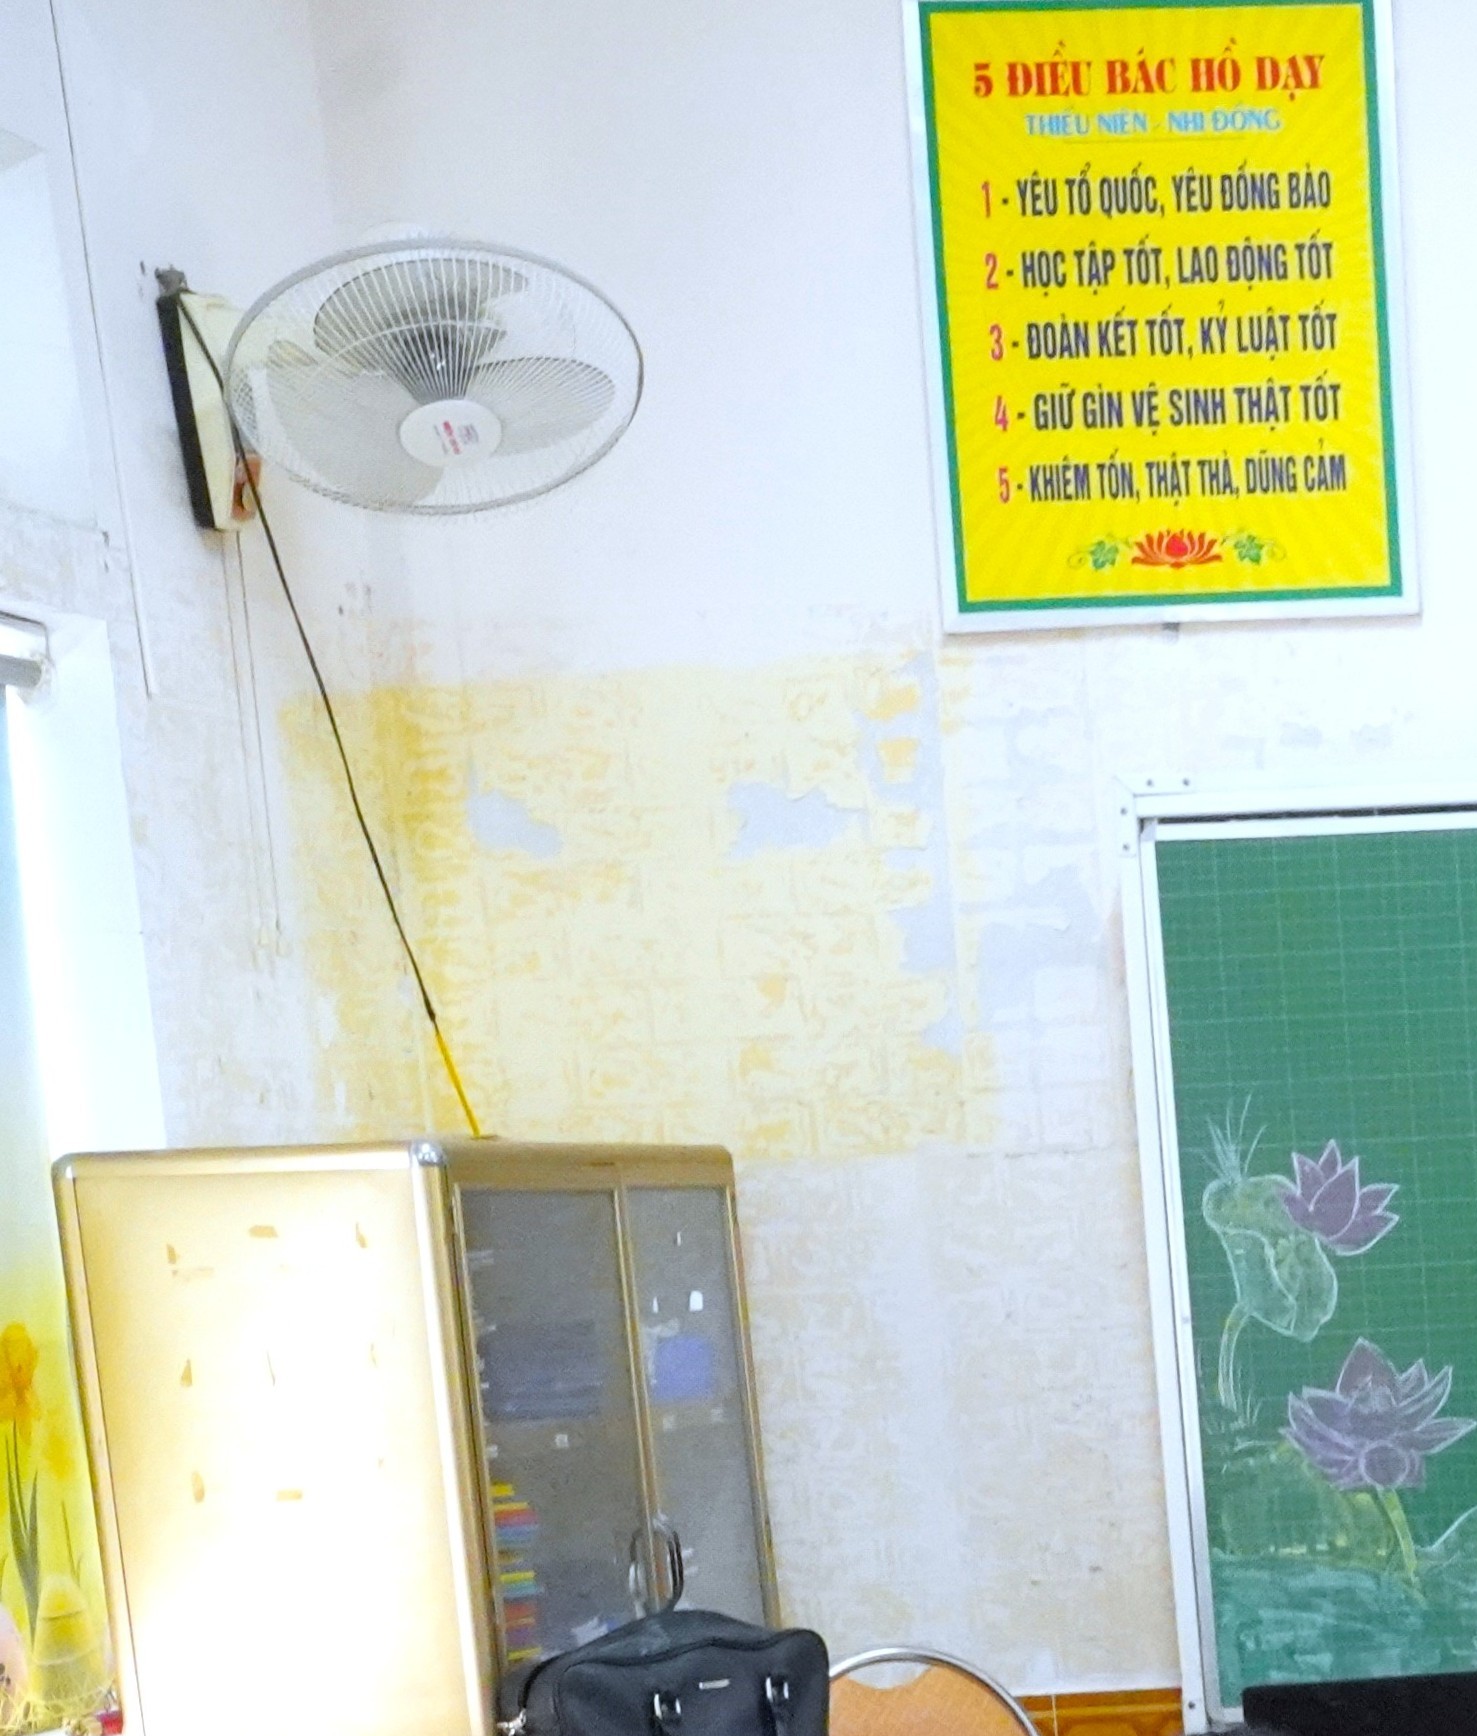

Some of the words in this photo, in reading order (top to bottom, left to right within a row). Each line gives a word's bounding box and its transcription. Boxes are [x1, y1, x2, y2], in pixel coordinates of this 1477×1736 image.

[974, 62, 993, 98] 5
[1006, 40, 1092, 97] ĐIỀU
[1105, 47, 1176, 94] BÁC
[1191, 37, 1241, 93] HỒ
[1256, 54, 1325, 101] DẠY
[1168, 109, 1204, 132] NHI
[982, 181, 992, 218] 1
[1017, 170, 1057, 217] YÊU
[1065, 162, 1091, 215] TỔ
[1100, 162, 1165, 219] QUỐC,
[1172, 167, 1212, 213] YÊU
[985, 252, 999, 290] 2
[1022, 250, 1067, 297] HỌC
[1074, 241, 1115, 296] TẬP
[1177, 246, 1218, 284] LAO
[1226, 236, 1288, 291] ĐỘNG
[1295, 228, 1333, 280] TỐT
[990, 324, 1003, 361] 3
[1027, 313, 1089, 359] ĐOÀN
[1097, 306, 1137, 357] KẾT
[1200, 300, 1228, 354] KỶ
[1236, 307, 1290, 361] LUẬT
[1298, 300, 1337, 351] TỐT
[995, 395, 1008, 432] 4
[1034, 382, 1075, 431] GIỮ
[1082, 383, 1123, 429] GÌN
[1131, 381, 1160, 436] VỆ
[1169, 388, 1226, 426] SINH
[1233, 377, 1291, 432] THẬT
[1300, 369, 1341, 422] TỐT
[998, 467, 1010, 503] 5
[1029, 455, 1091, 502] KHIÊM
[1146, 452, 1190, 507] THẬT
[1246, 451, 1297, 495] DŨNG
[1304, 438, 1347, 492] CẢM
